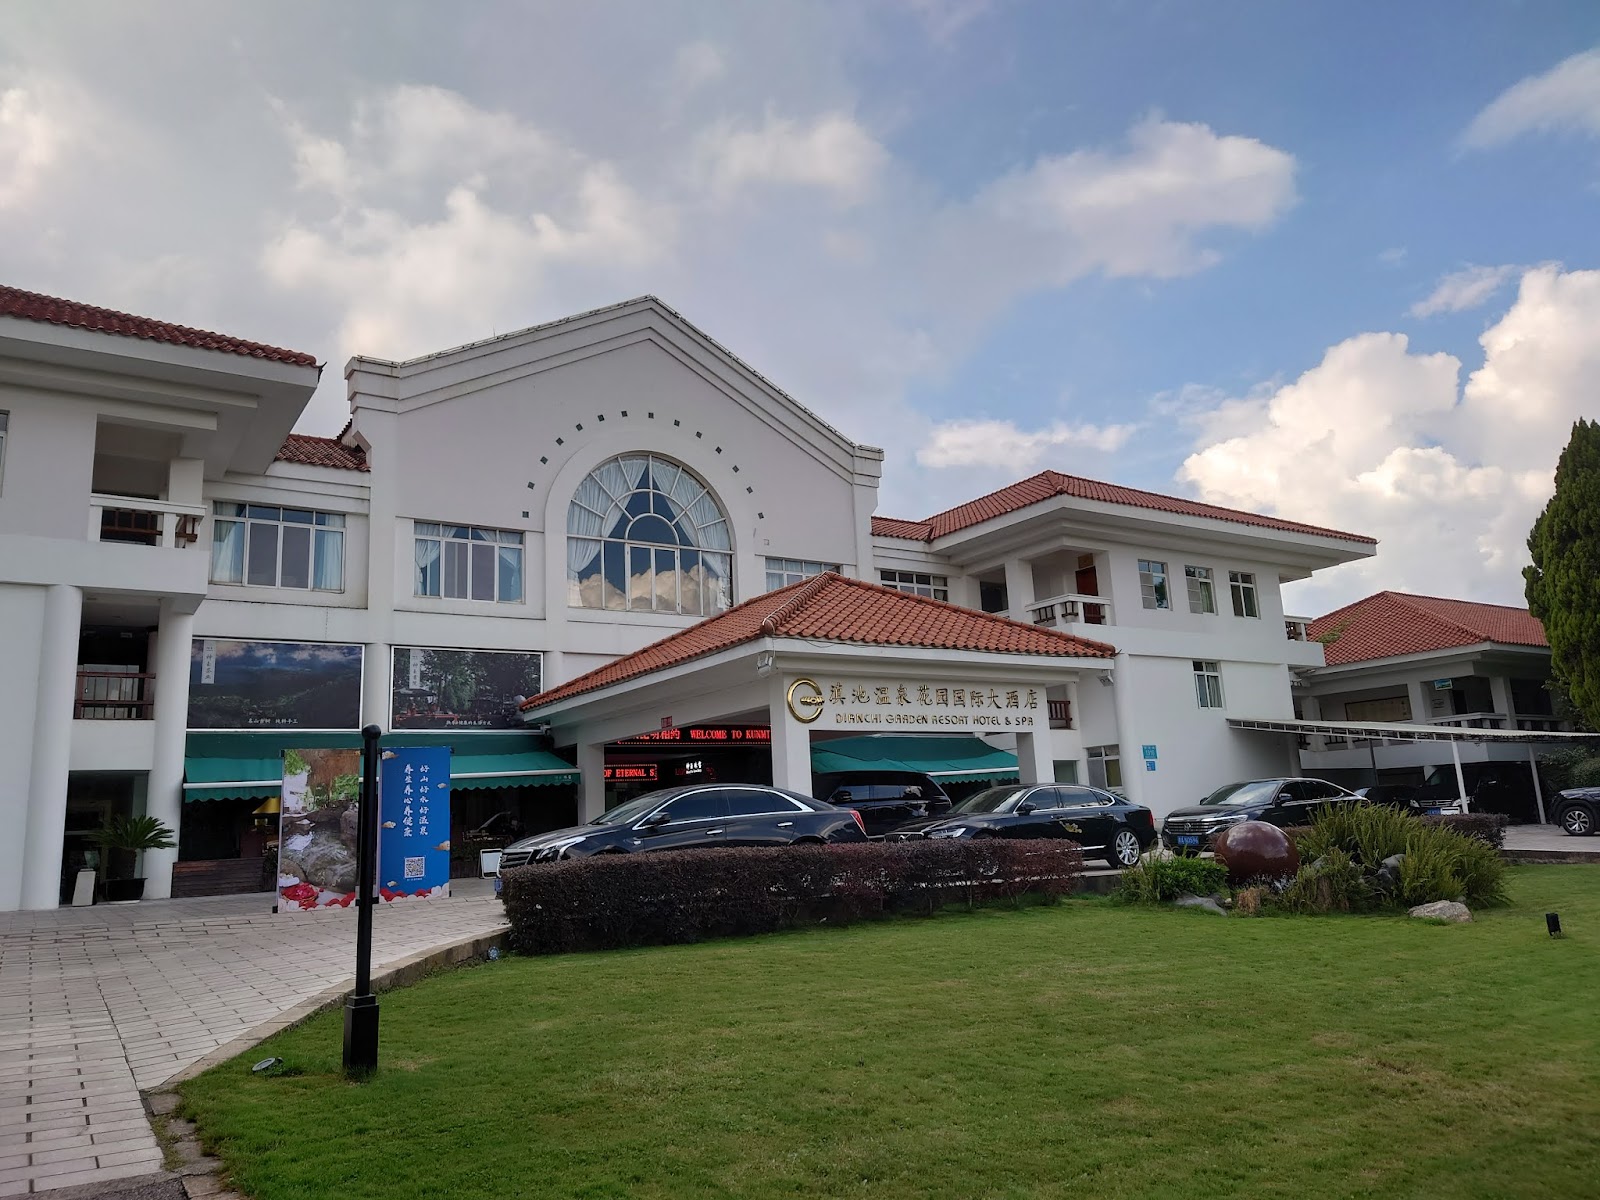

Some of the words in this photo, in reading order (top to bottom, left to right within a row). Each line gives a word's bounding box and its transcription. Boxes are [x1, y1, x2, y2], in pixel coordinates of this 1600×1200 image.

[829, 682, 1038, 710] 滇池温泉花园国际大酒店
[836, 713, 882, 724] DIANCHI
[886, 714, 928, 725] GARDEN
[932, 714, 969, 725] RESORT
[973, 715, 1001, 726] HOTEL
[1005, 716, 1012, 726] &
[1015, 716, 1034, 726] SPA
[690, 729, 727, 740] WELCOME
[731, 729, 742, 740] TO
[615, 768, 647, 778] ETERNAL
[403, 763, 414, 837] 养生养心养健康
[419, 764, 430, 835] 好山好水好温泉
